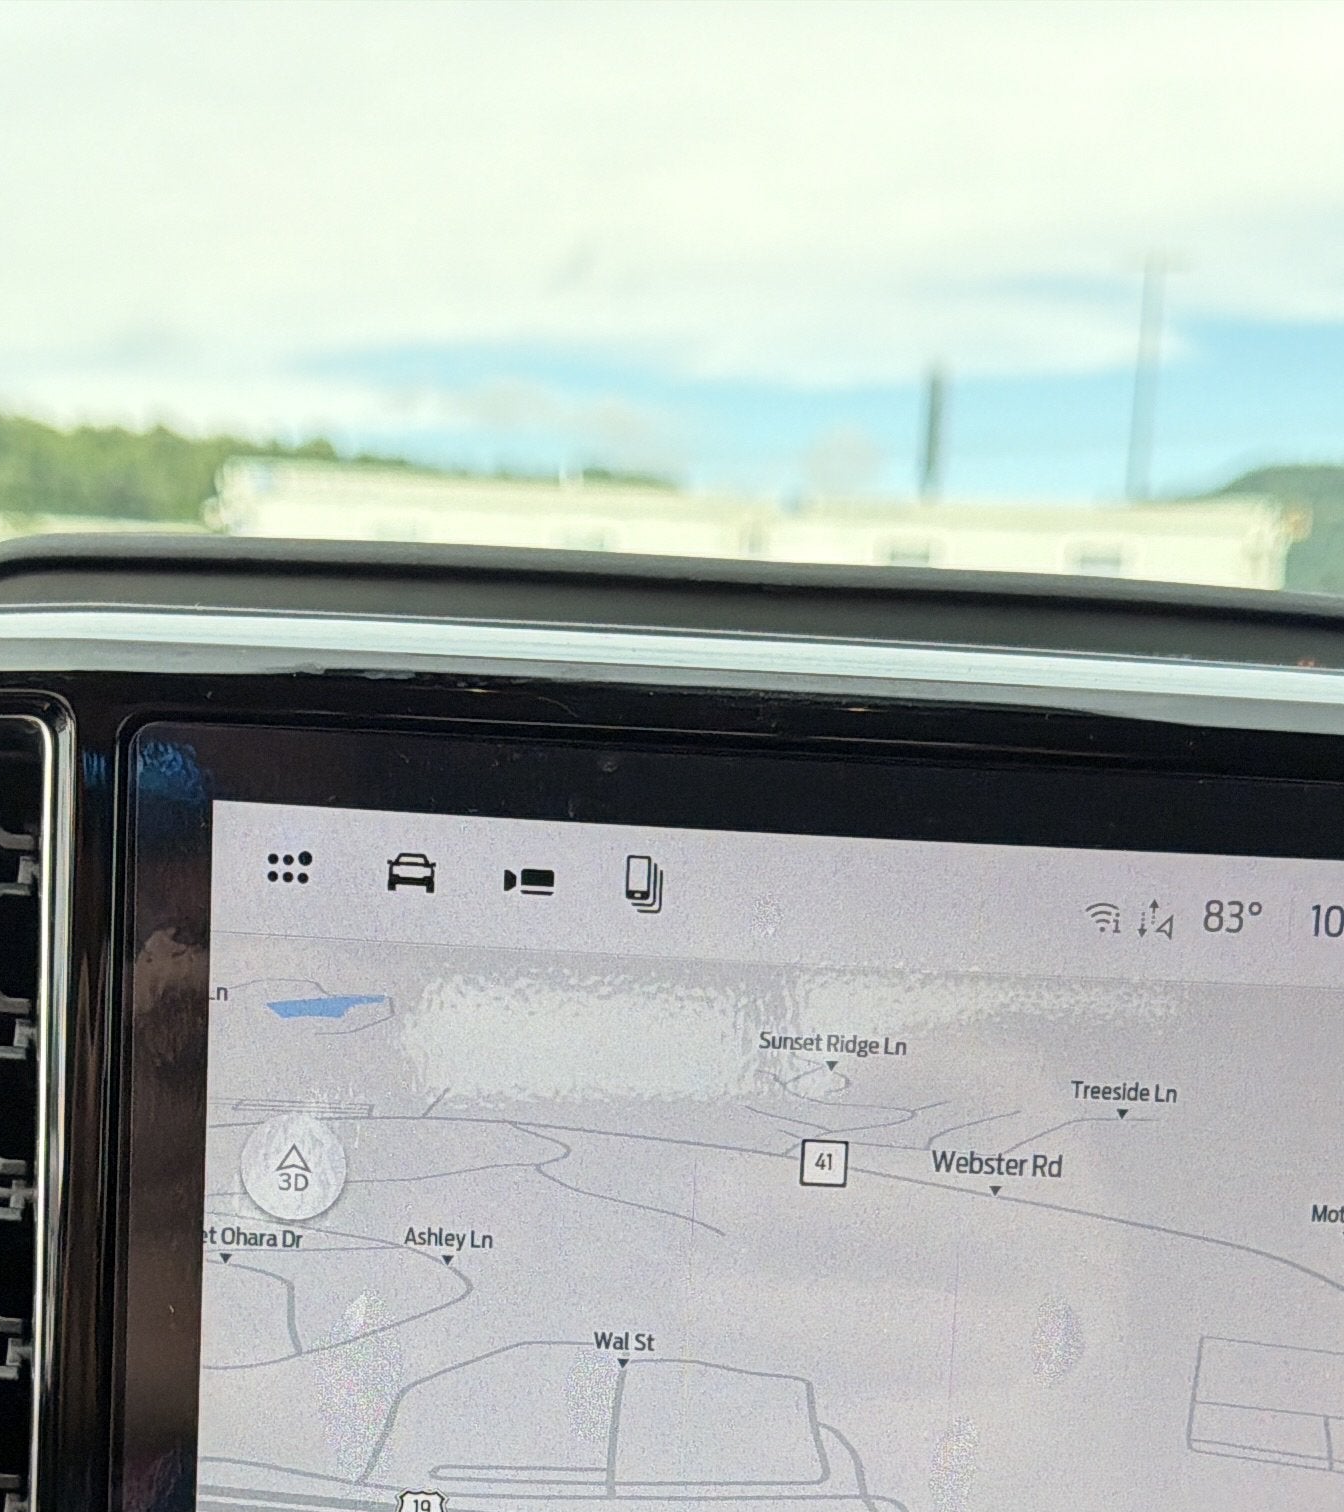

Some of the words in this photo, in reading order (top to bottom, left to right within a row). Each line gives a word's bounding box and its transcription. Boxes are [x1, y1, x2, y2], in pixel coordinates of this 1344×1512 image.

[1203, 899, 1263, 934] 83°
[759, 1031, 823, 1052] Sunset
[827, 1034, 880, 1058] Ridge
[884, 1037, 907, 1056] Ln
[1071, 1080, 1149, 1104] Treeside
[1155, 1083, 1178, 1104] Ln
[813, 1152, 835, 1172] 41
[932, 1149, 1027, 1178] Webster
[1032, 1153, 1063, 1179] Rd
[278, 1172, 309, 1192] 3D
[221, 1226, 278, 1247] Ohara
[282, 1229, 303, 1249] Dr
[404, 1226, 466, 1251] Ashley
[470, 1230, 493, 1249] Ln
[594, 1331, 630, 1350] Wal
[634, 1333, 655, 1352] St
